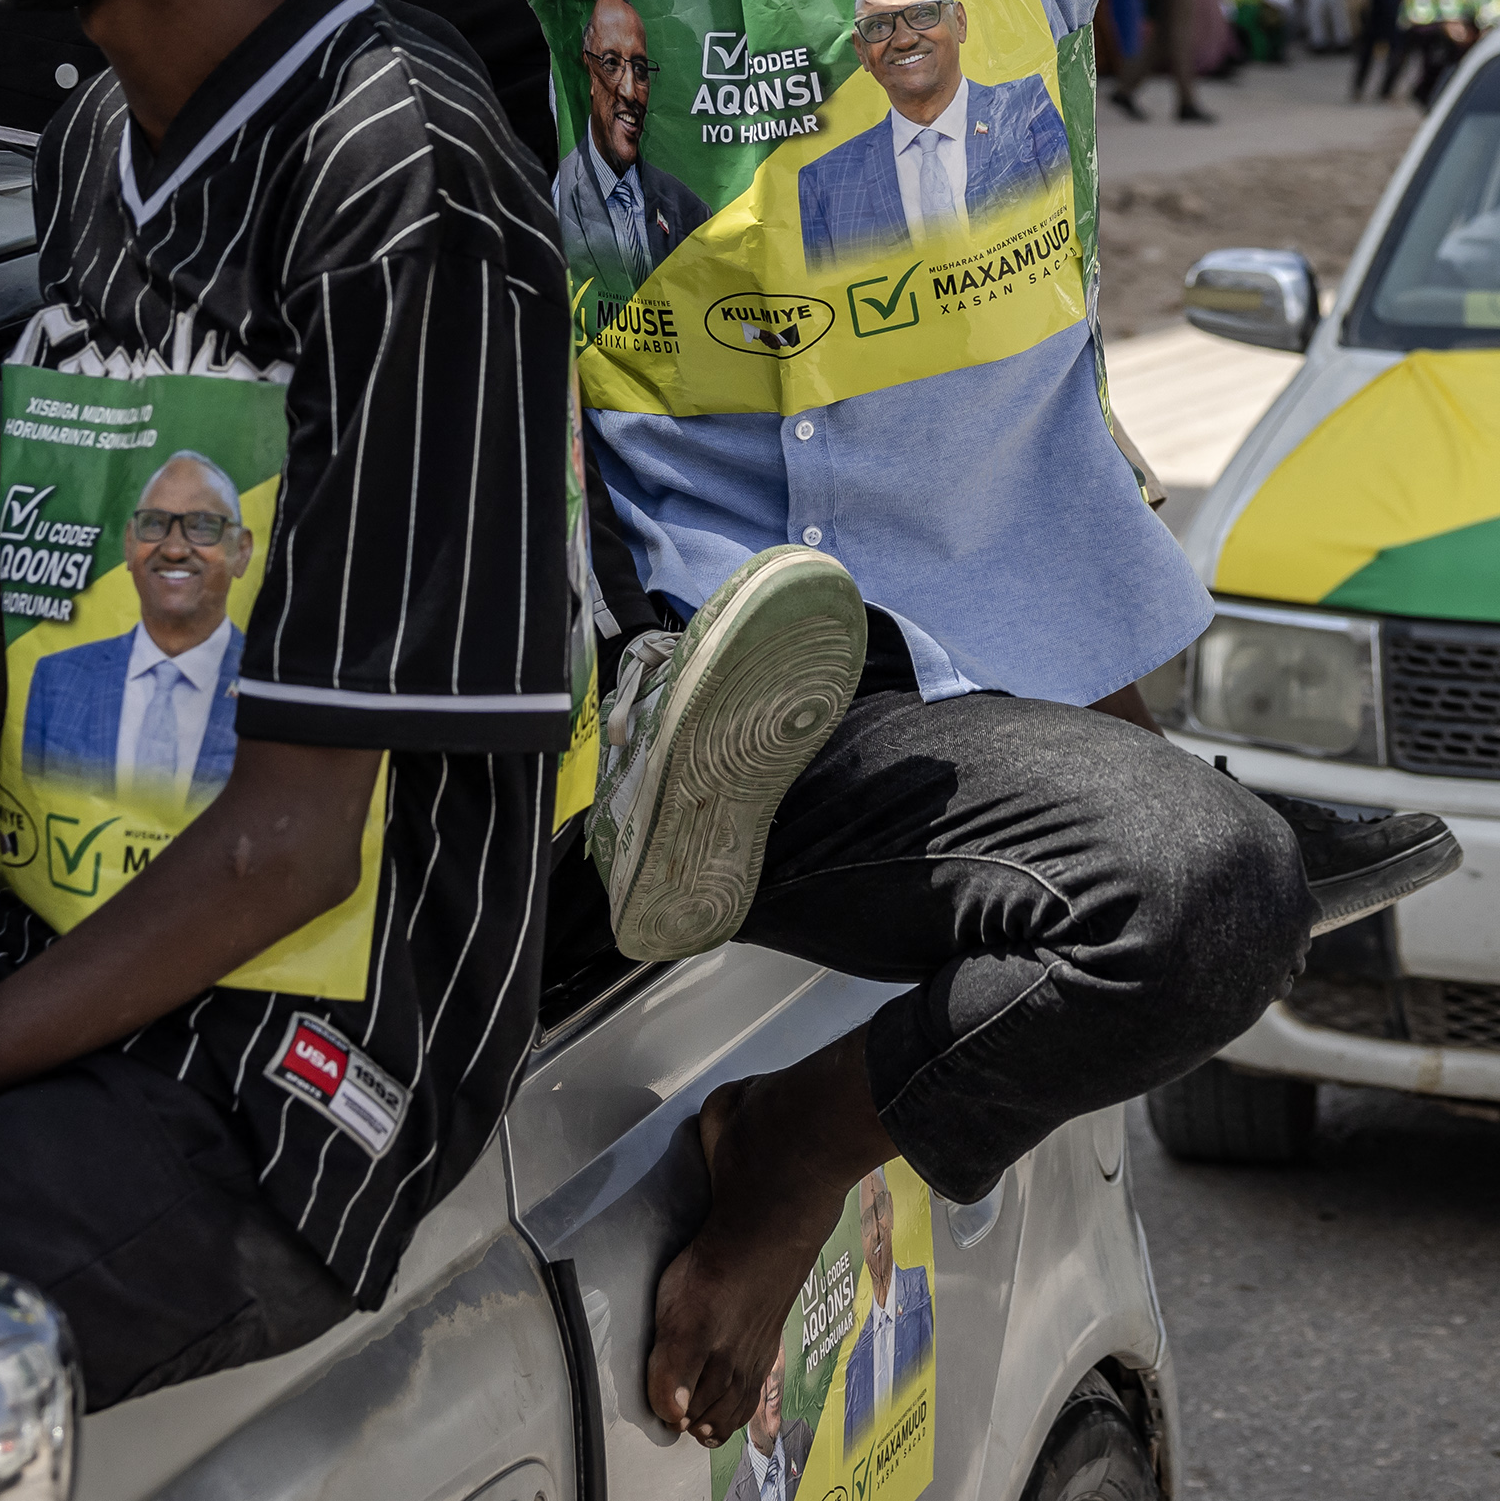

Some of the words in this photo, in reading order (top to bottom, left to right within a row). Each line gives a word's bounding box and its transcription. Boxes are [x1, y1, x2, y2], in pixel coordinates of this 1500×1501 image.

[702, 124, 733, 143] IYO
[929, 253, 984, 274] MUSHARAXA
[986, 225, 1039, 256] MADAXWEYNE
[933, 218, 1070, 299] MAXAMUUD
[720, 304, 812, 325] KULMIYE
[940, 283, 1013, 315] XASAN
[597, 300, 678, 337] MUUSE
[596, 333, 626, 350] BIIXI
[634, 338, 680, 354] CABDI
[25, 397, 79, 421] XISBIGA
[4, 418, 95, 448] HORUMARINTA
[34, 521, 51, 541] U
[48, 523, 101, 547] CODEE
[295, 1040, 339, 1079] USA
[827, 1251, 850, 1287] CODEE
[802, 1272, 854, 1353] AQOONSI
[806, 1349, 818, 1374] IYO
[820, 1311, 853, 1360] HORUMAR
[876, 1400, 926, 1476] MAXAMUUD
